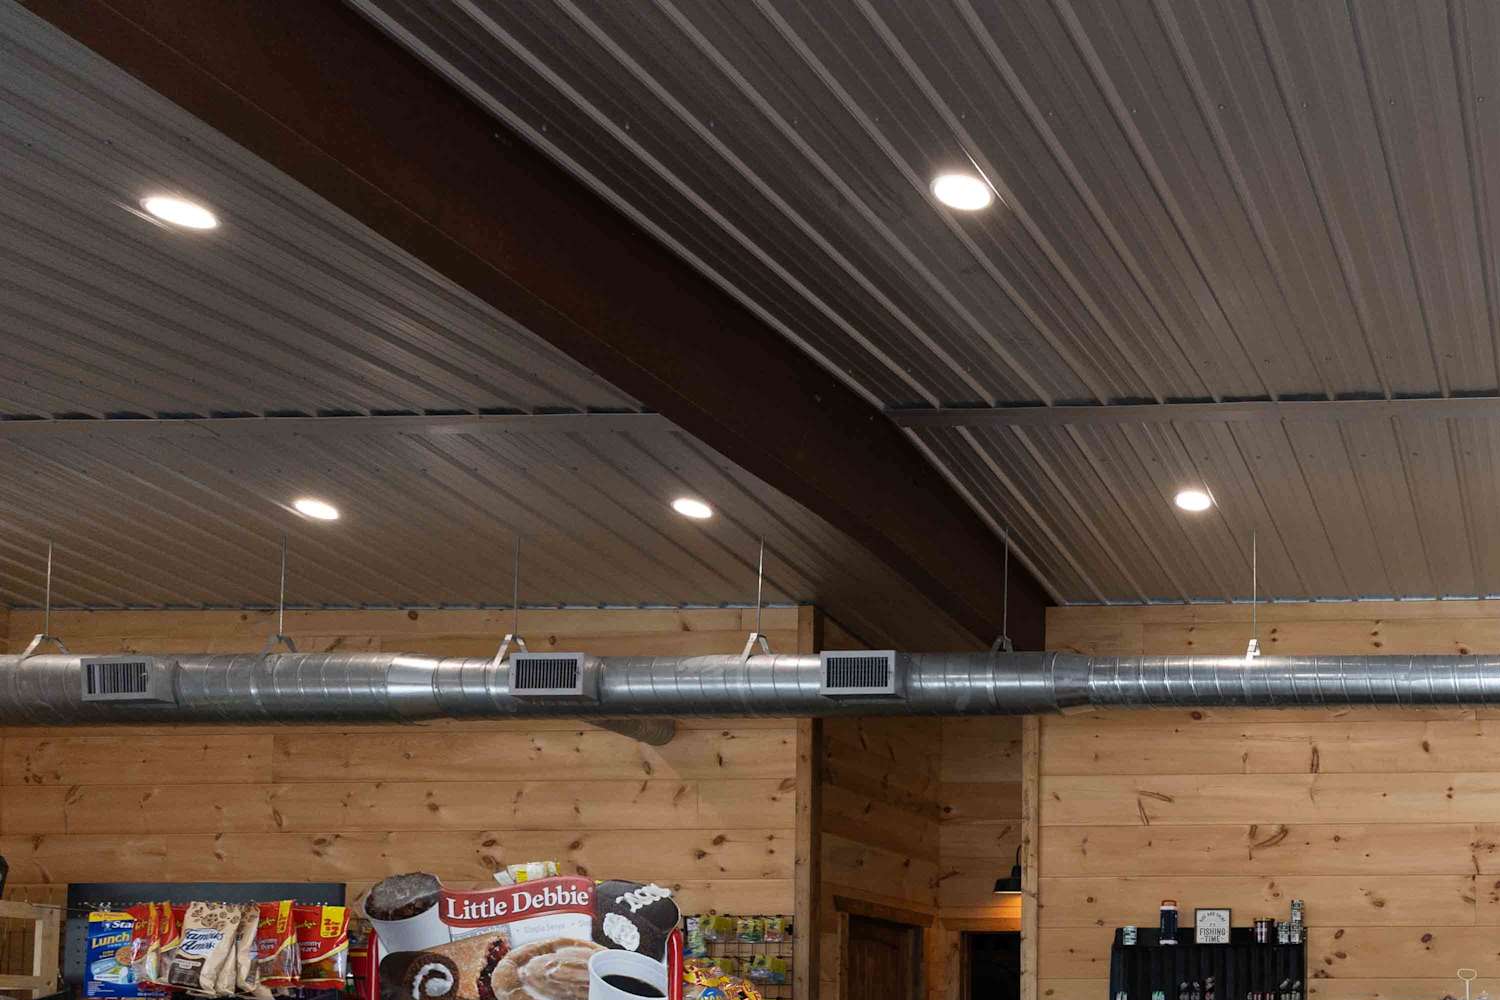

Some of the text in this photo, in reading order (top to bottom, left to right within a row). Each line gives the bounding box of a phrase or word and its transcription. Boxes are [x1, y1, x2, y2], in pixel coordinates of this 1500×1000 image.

[446, 885, 589, 920] Little Debbie
[92, 931, 131, 949] Lunch
[1200, 928, 1226, 936] FISHING
